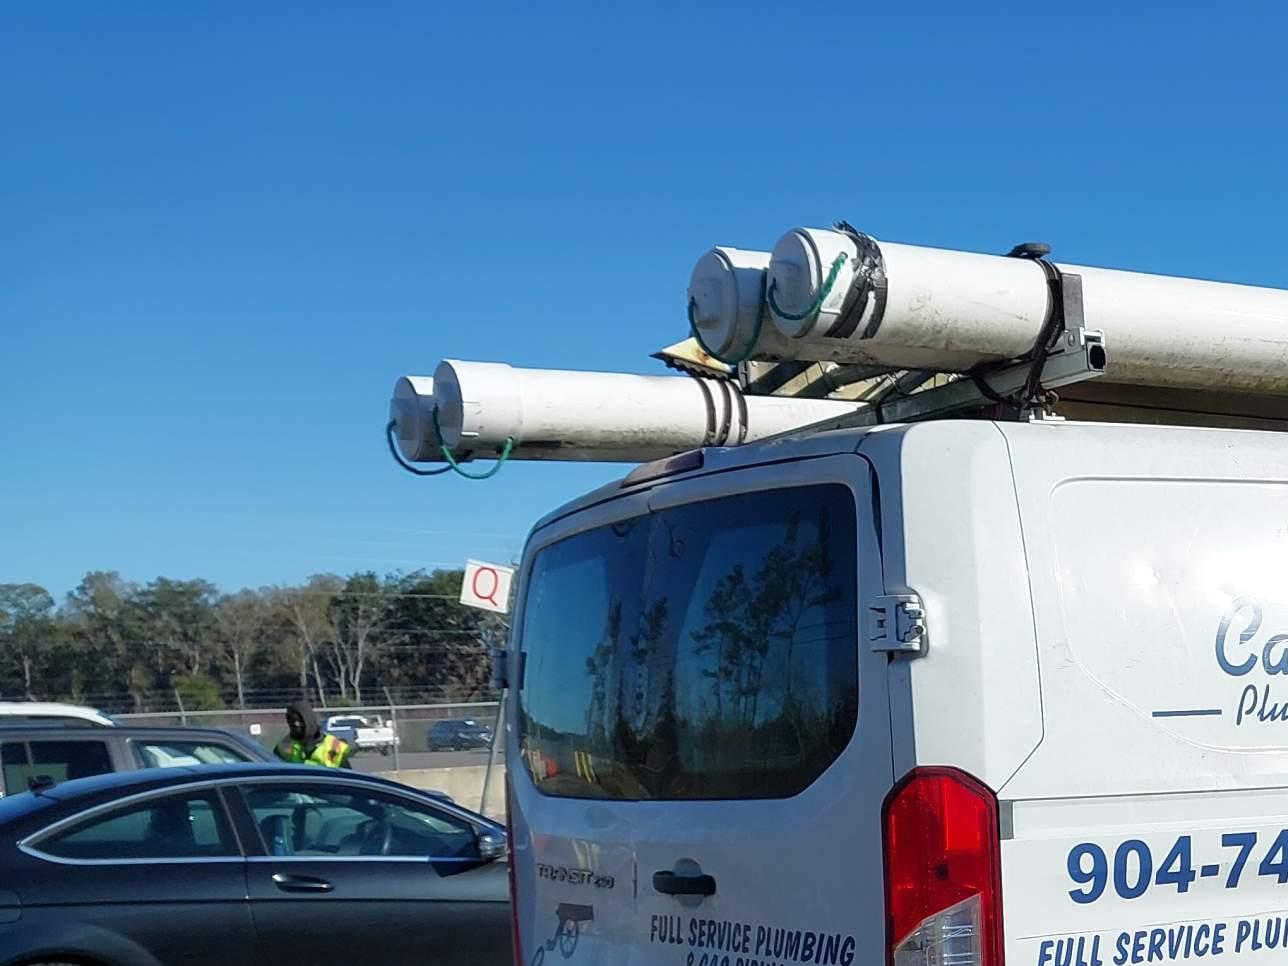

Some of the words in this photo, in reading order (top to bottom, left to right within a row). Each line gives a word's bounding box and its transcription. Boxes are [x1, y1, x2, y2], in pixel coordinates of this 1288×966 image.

[473, 567, 498, 607] Q
[650, 915, 684, 945] FULL
[687, 917, 751, 953] SERVICE
[1112, 923, 1227, 966] SERVICE
